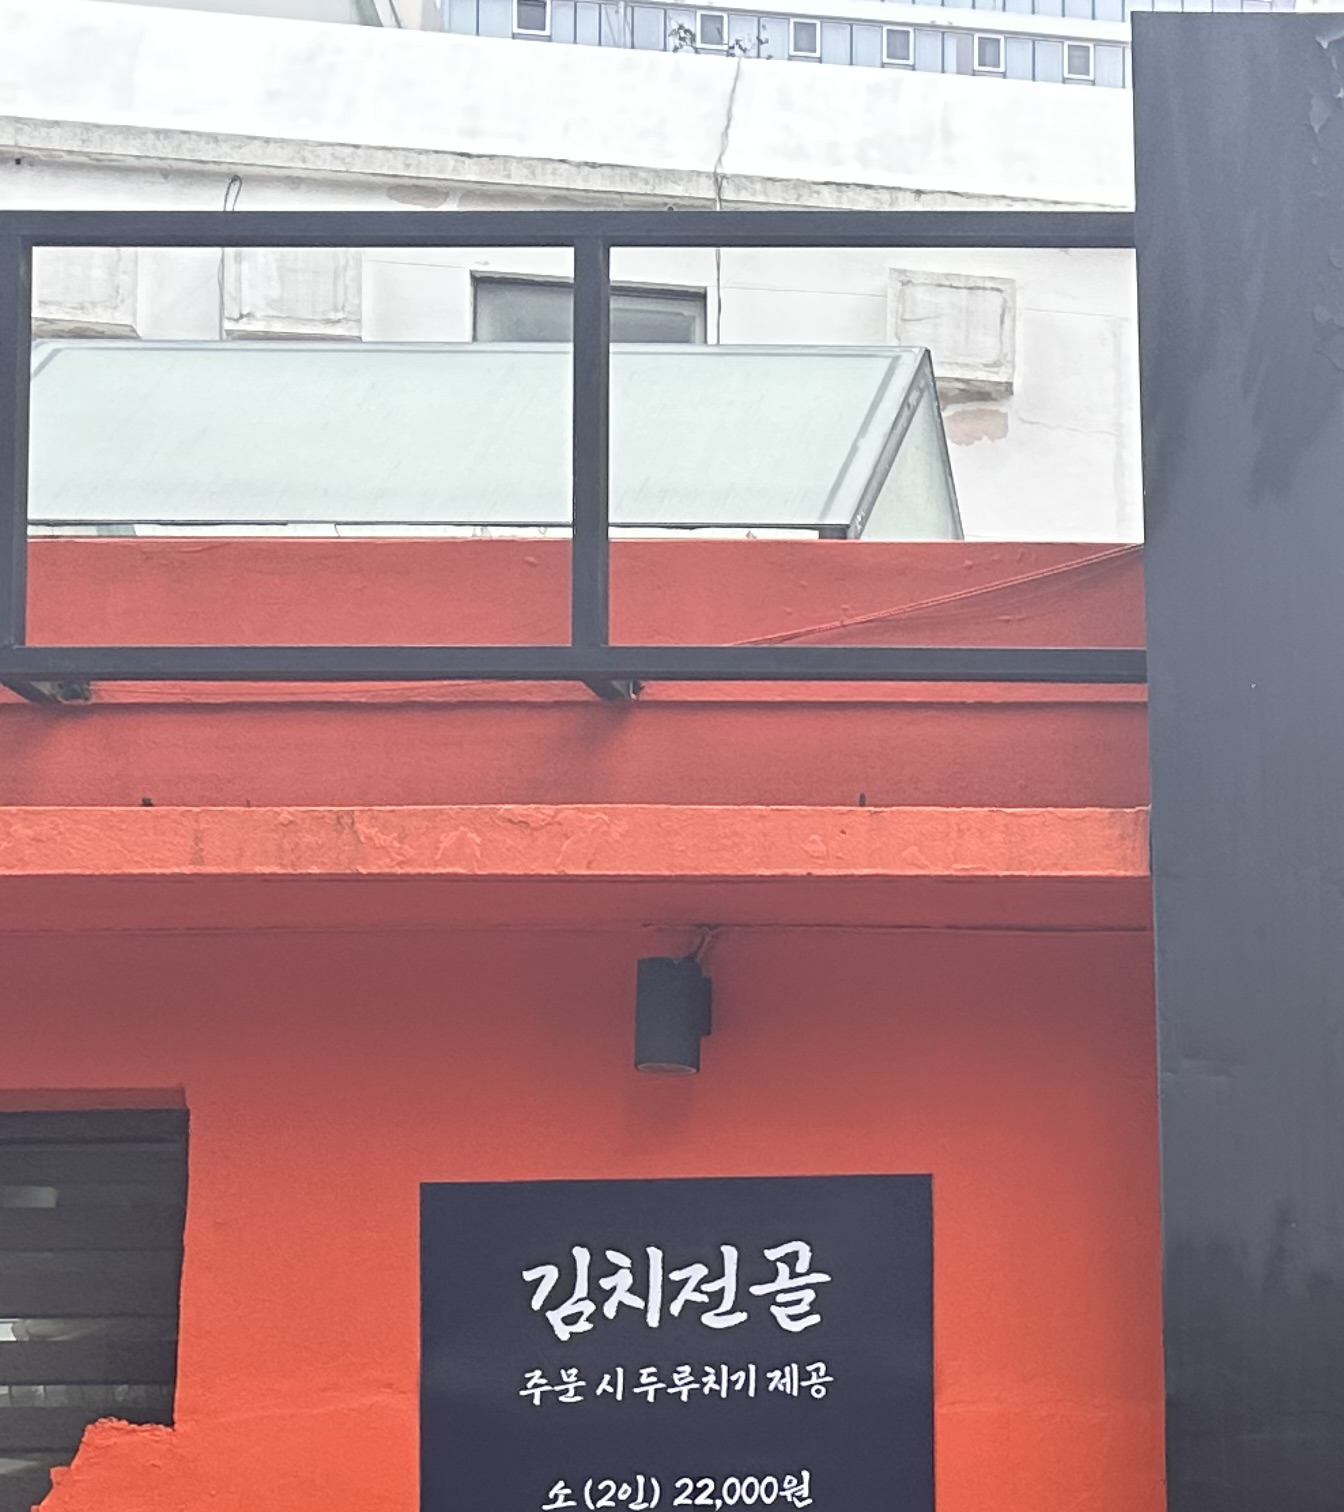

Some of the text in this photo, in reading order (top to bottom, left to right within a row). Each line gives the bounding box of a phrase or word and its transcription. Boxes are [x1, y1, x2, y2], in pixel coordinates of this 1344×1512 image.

[522, 1240, 831, 1340] 김치전골
[519, 1368, 587, 1404] 주문
[633, 1364, 756, 1402] 두루치기
[765, 1361, 834, 1399] 제공
[673, 1469, 813, 1510] 22,000원
